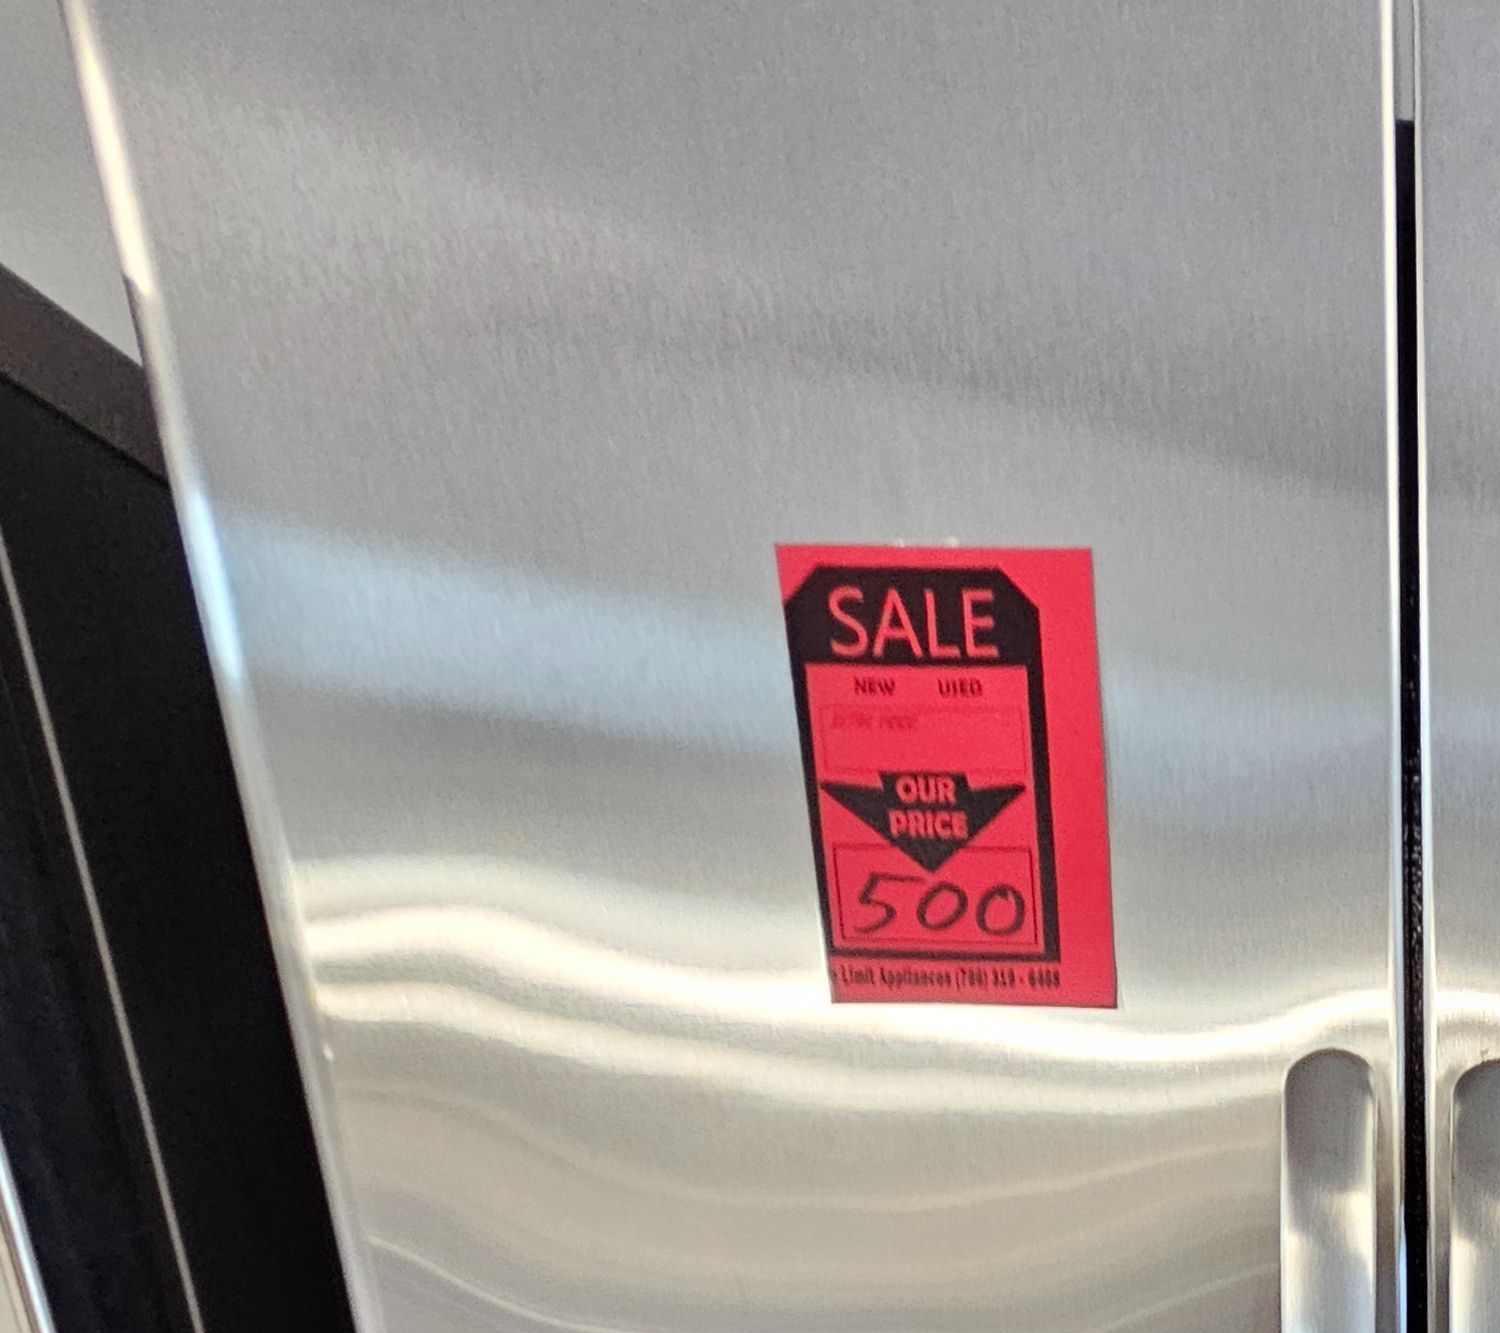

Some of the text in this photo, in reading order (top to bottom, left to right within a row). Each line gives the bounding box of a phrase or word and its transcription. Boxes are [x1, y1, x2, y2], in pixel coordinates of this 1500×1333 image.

[828, 586, 999, 660] SALE
[853, 677, 983, 698] NEW USED
[896, 775, 957, 804] OUR
[889, 810, 969, 840] PRICE
[853, 872, 1026, 938] 500
[841, 965, 875, 986] Limit
[880, 966, 951, 990] Appliances
